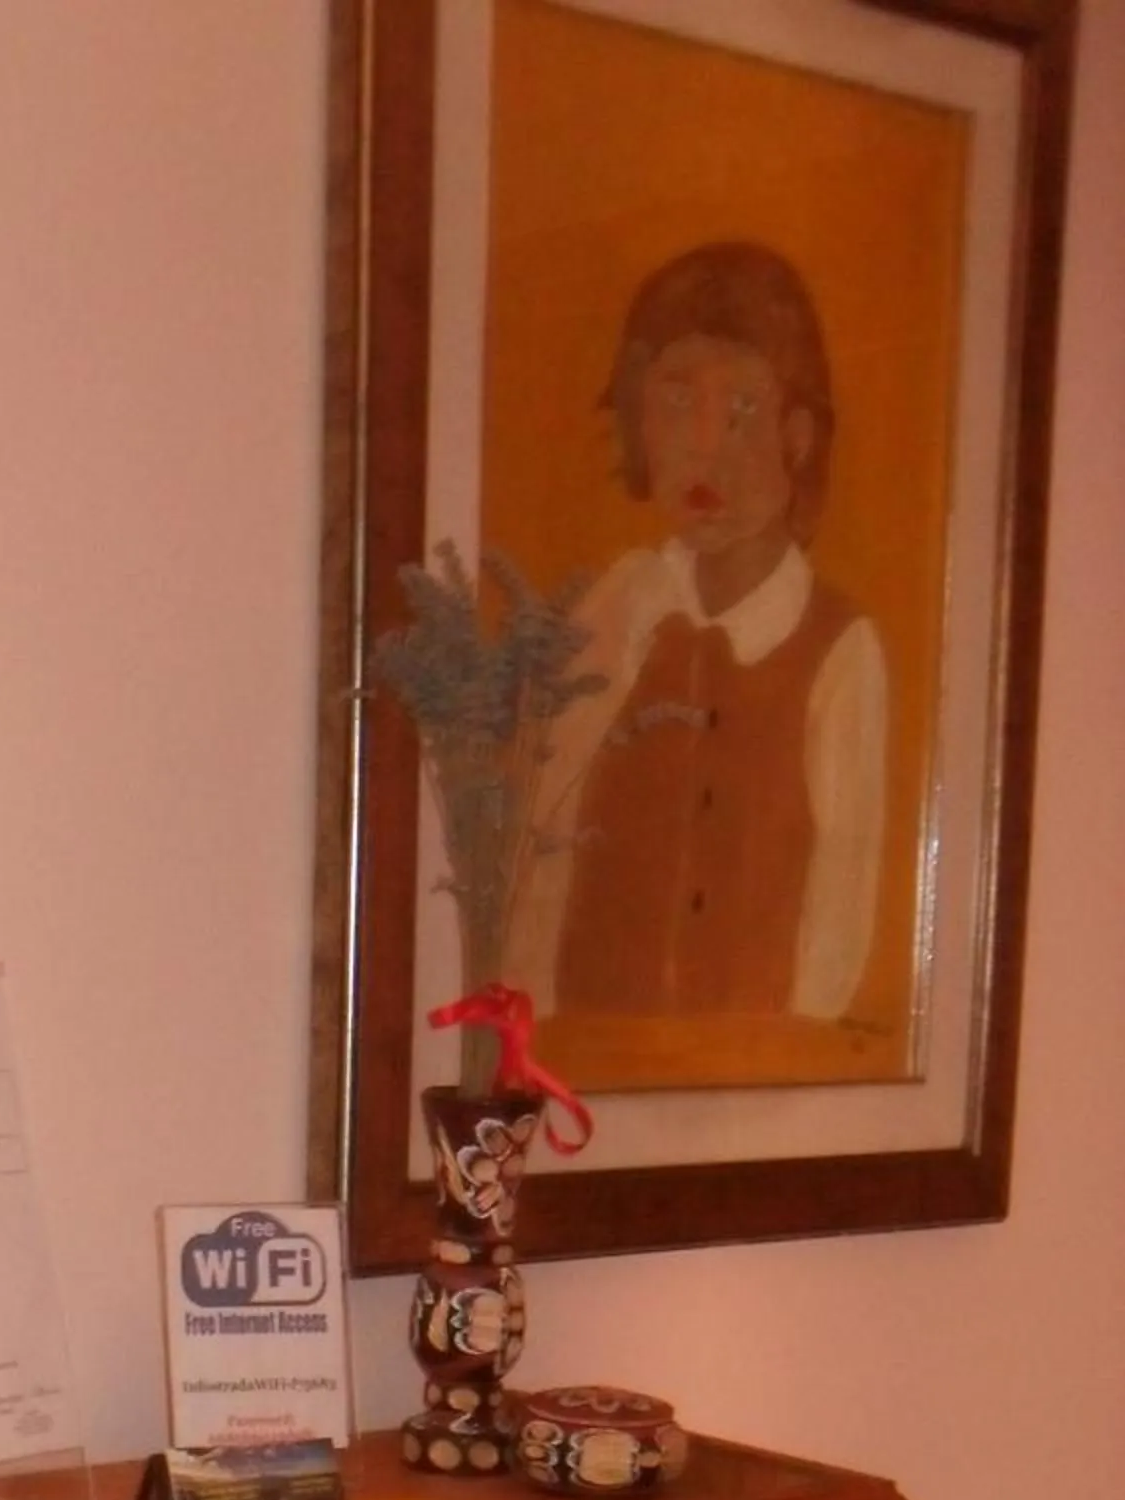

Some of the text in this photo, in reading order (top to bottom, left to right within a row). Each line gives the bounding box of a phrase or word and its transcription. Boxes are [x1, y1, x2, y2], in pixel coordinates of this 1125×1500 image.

[231, 1217, 276, 1238] Free
[192, 1248, 313, 1290] Wi Fi
[185, 1312, 328, 1336] Free Internet Access
